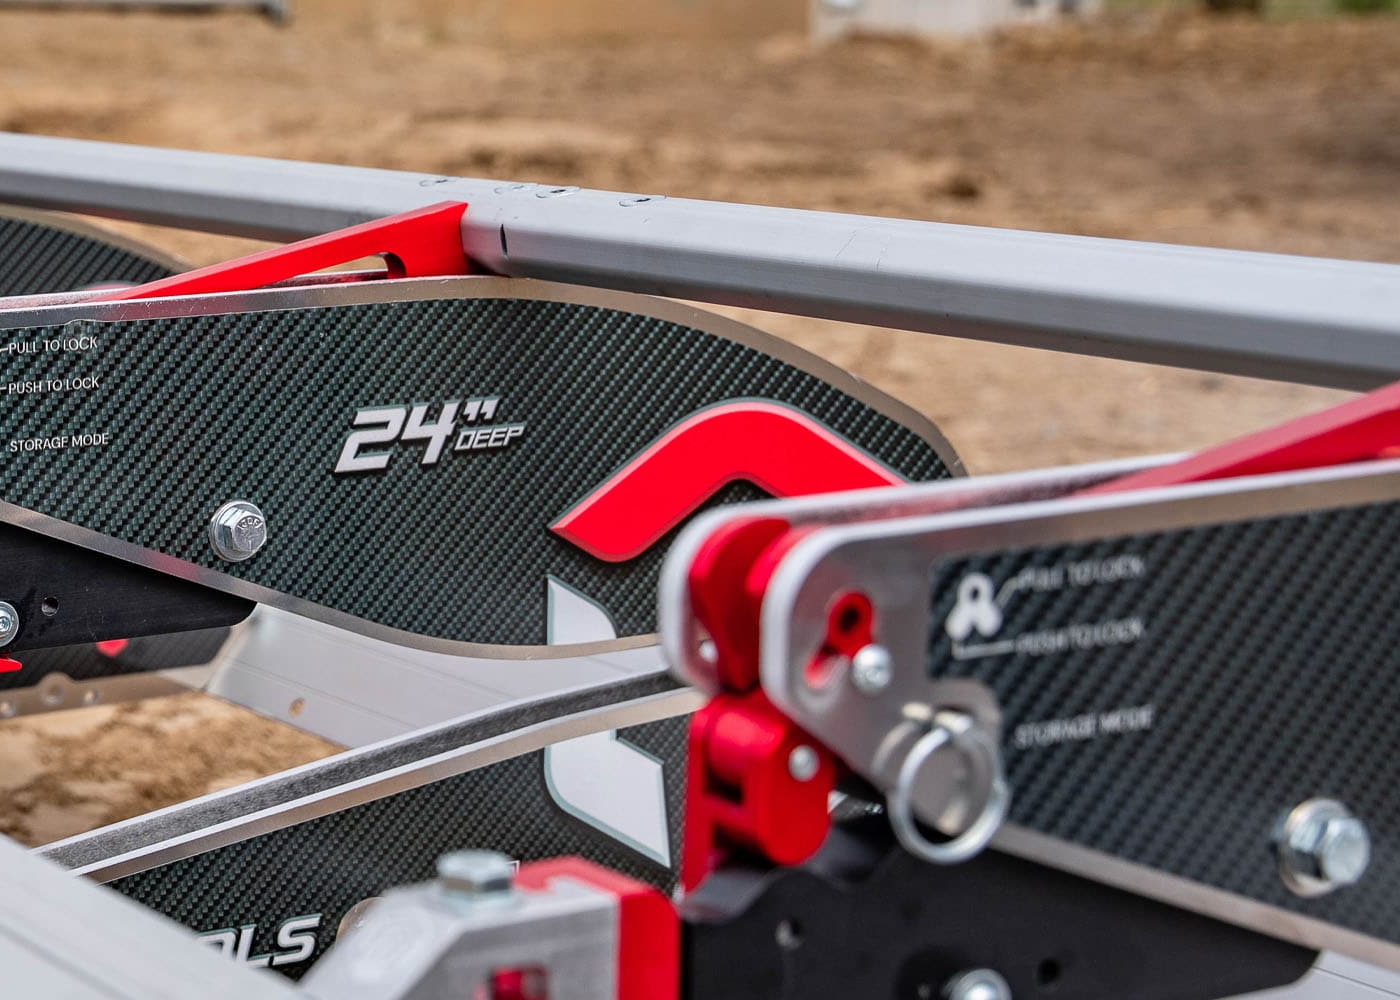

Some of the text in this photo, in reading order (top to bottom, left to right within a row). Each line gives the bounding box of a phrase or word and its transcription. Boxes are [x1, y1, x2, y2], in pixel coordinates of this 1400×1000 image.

[9, 336, 98, 354] PULL TO LOCK
[8, 375, 100, 395] PUSH TO LOCK
[10, 432, 110, 452] STORAGE MODE
[454, 425, 525, 451] DEEP
[1014, 704, 1156, 749] STORAGE MODE
